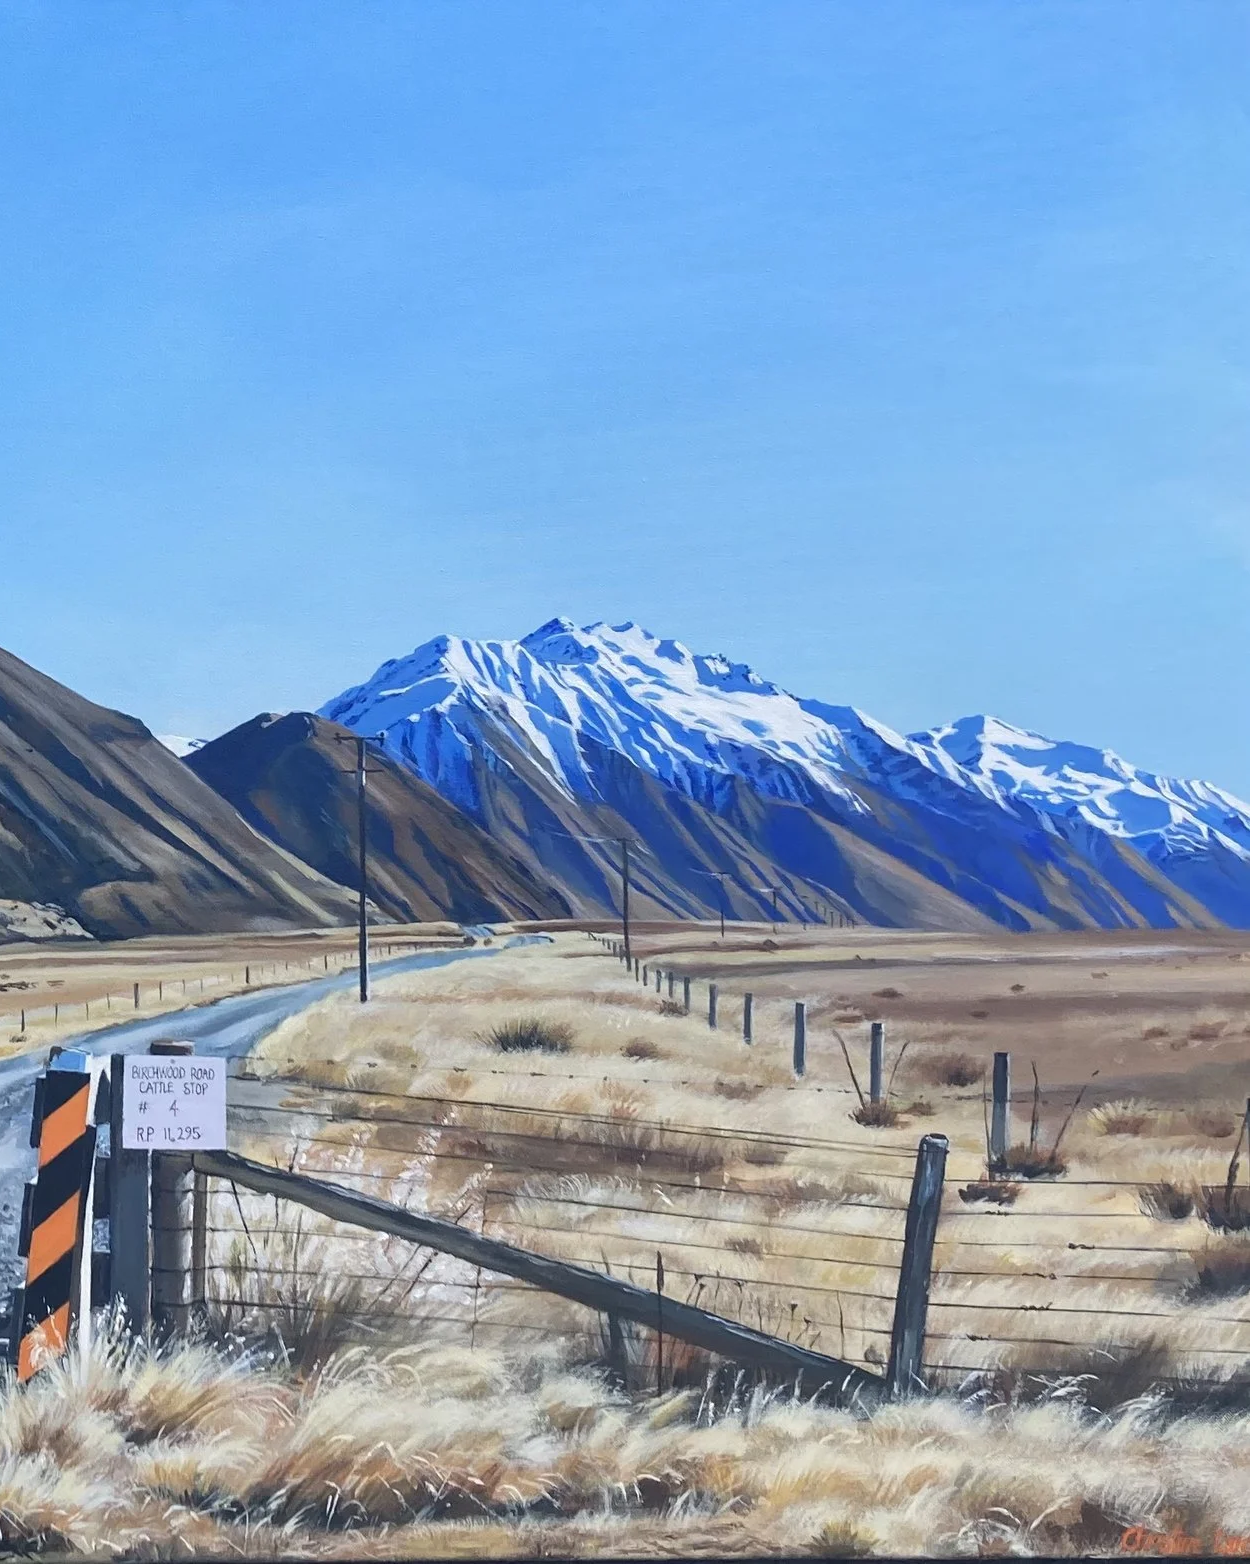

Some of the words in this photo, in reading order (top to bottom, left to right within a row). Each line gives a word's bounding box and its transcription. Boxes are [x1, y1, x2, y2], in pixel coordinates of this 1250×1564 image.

[131, 1065, 186, 1080] BIRCHWOOD
[190, 1067, 215, 1081] ROAD
[139, 1081, 175, 1095] CATTLE
[183, 1082, 209, 1096] STOP
[138, 1101, 148, 1114] #
[169, 1099, 179, 1117] 4
